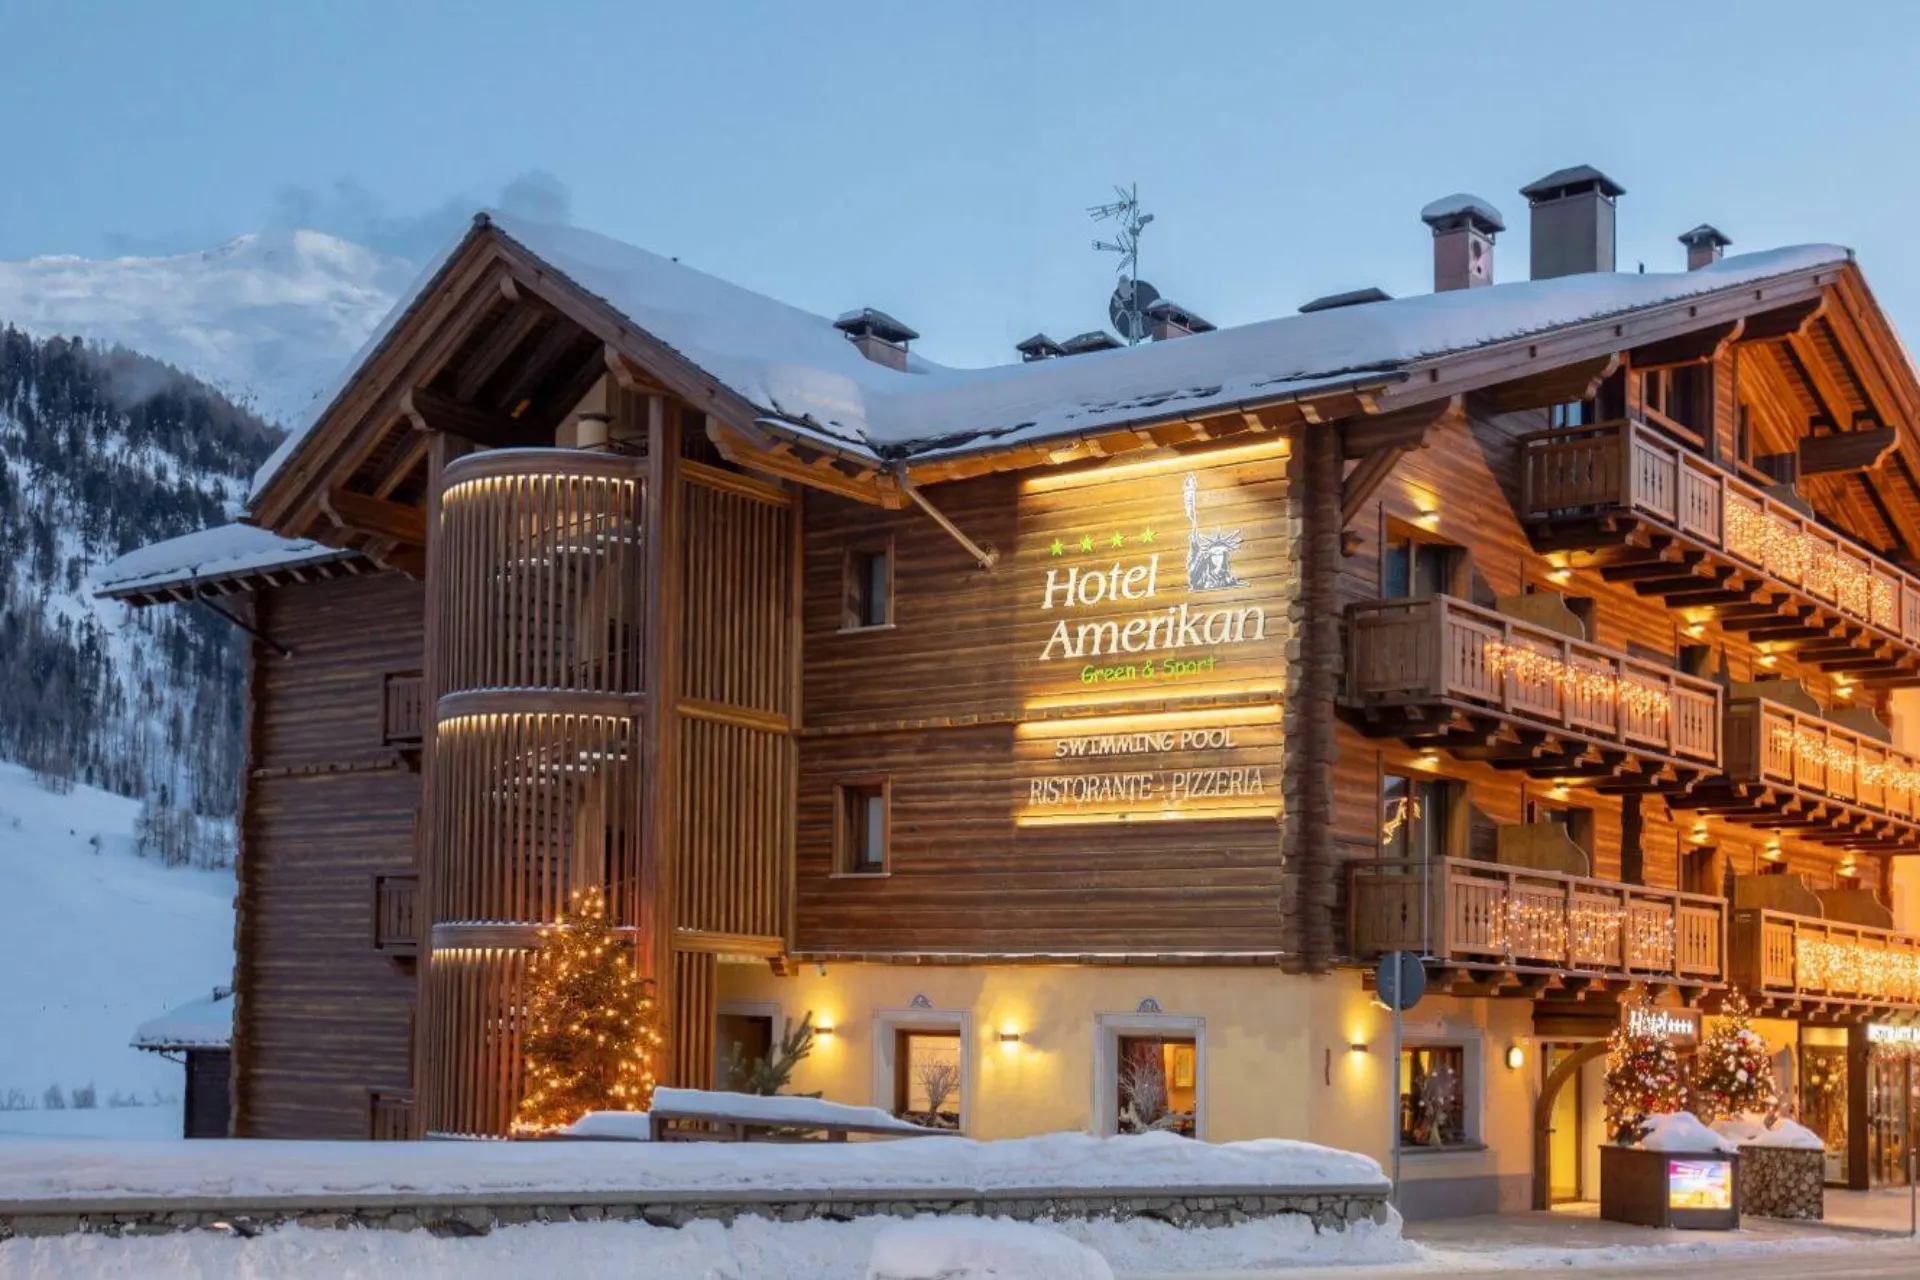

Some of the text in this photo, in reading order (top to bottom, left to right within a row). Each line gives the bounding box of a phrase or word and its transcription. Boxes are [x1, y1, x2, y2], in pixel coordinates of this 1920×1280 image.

[1041, 553, 1159, 610] Hotel
[1039, 602, 1266, 661] Amerikan
[1081, 655, 1216, 684] Green & Sport
[1055, 728, 1236, 757] SWIMMING POOL
[1028, 773, 1154, 805] RISTORANTE
[1171, 767, 1265, 799] PIZZERIA
